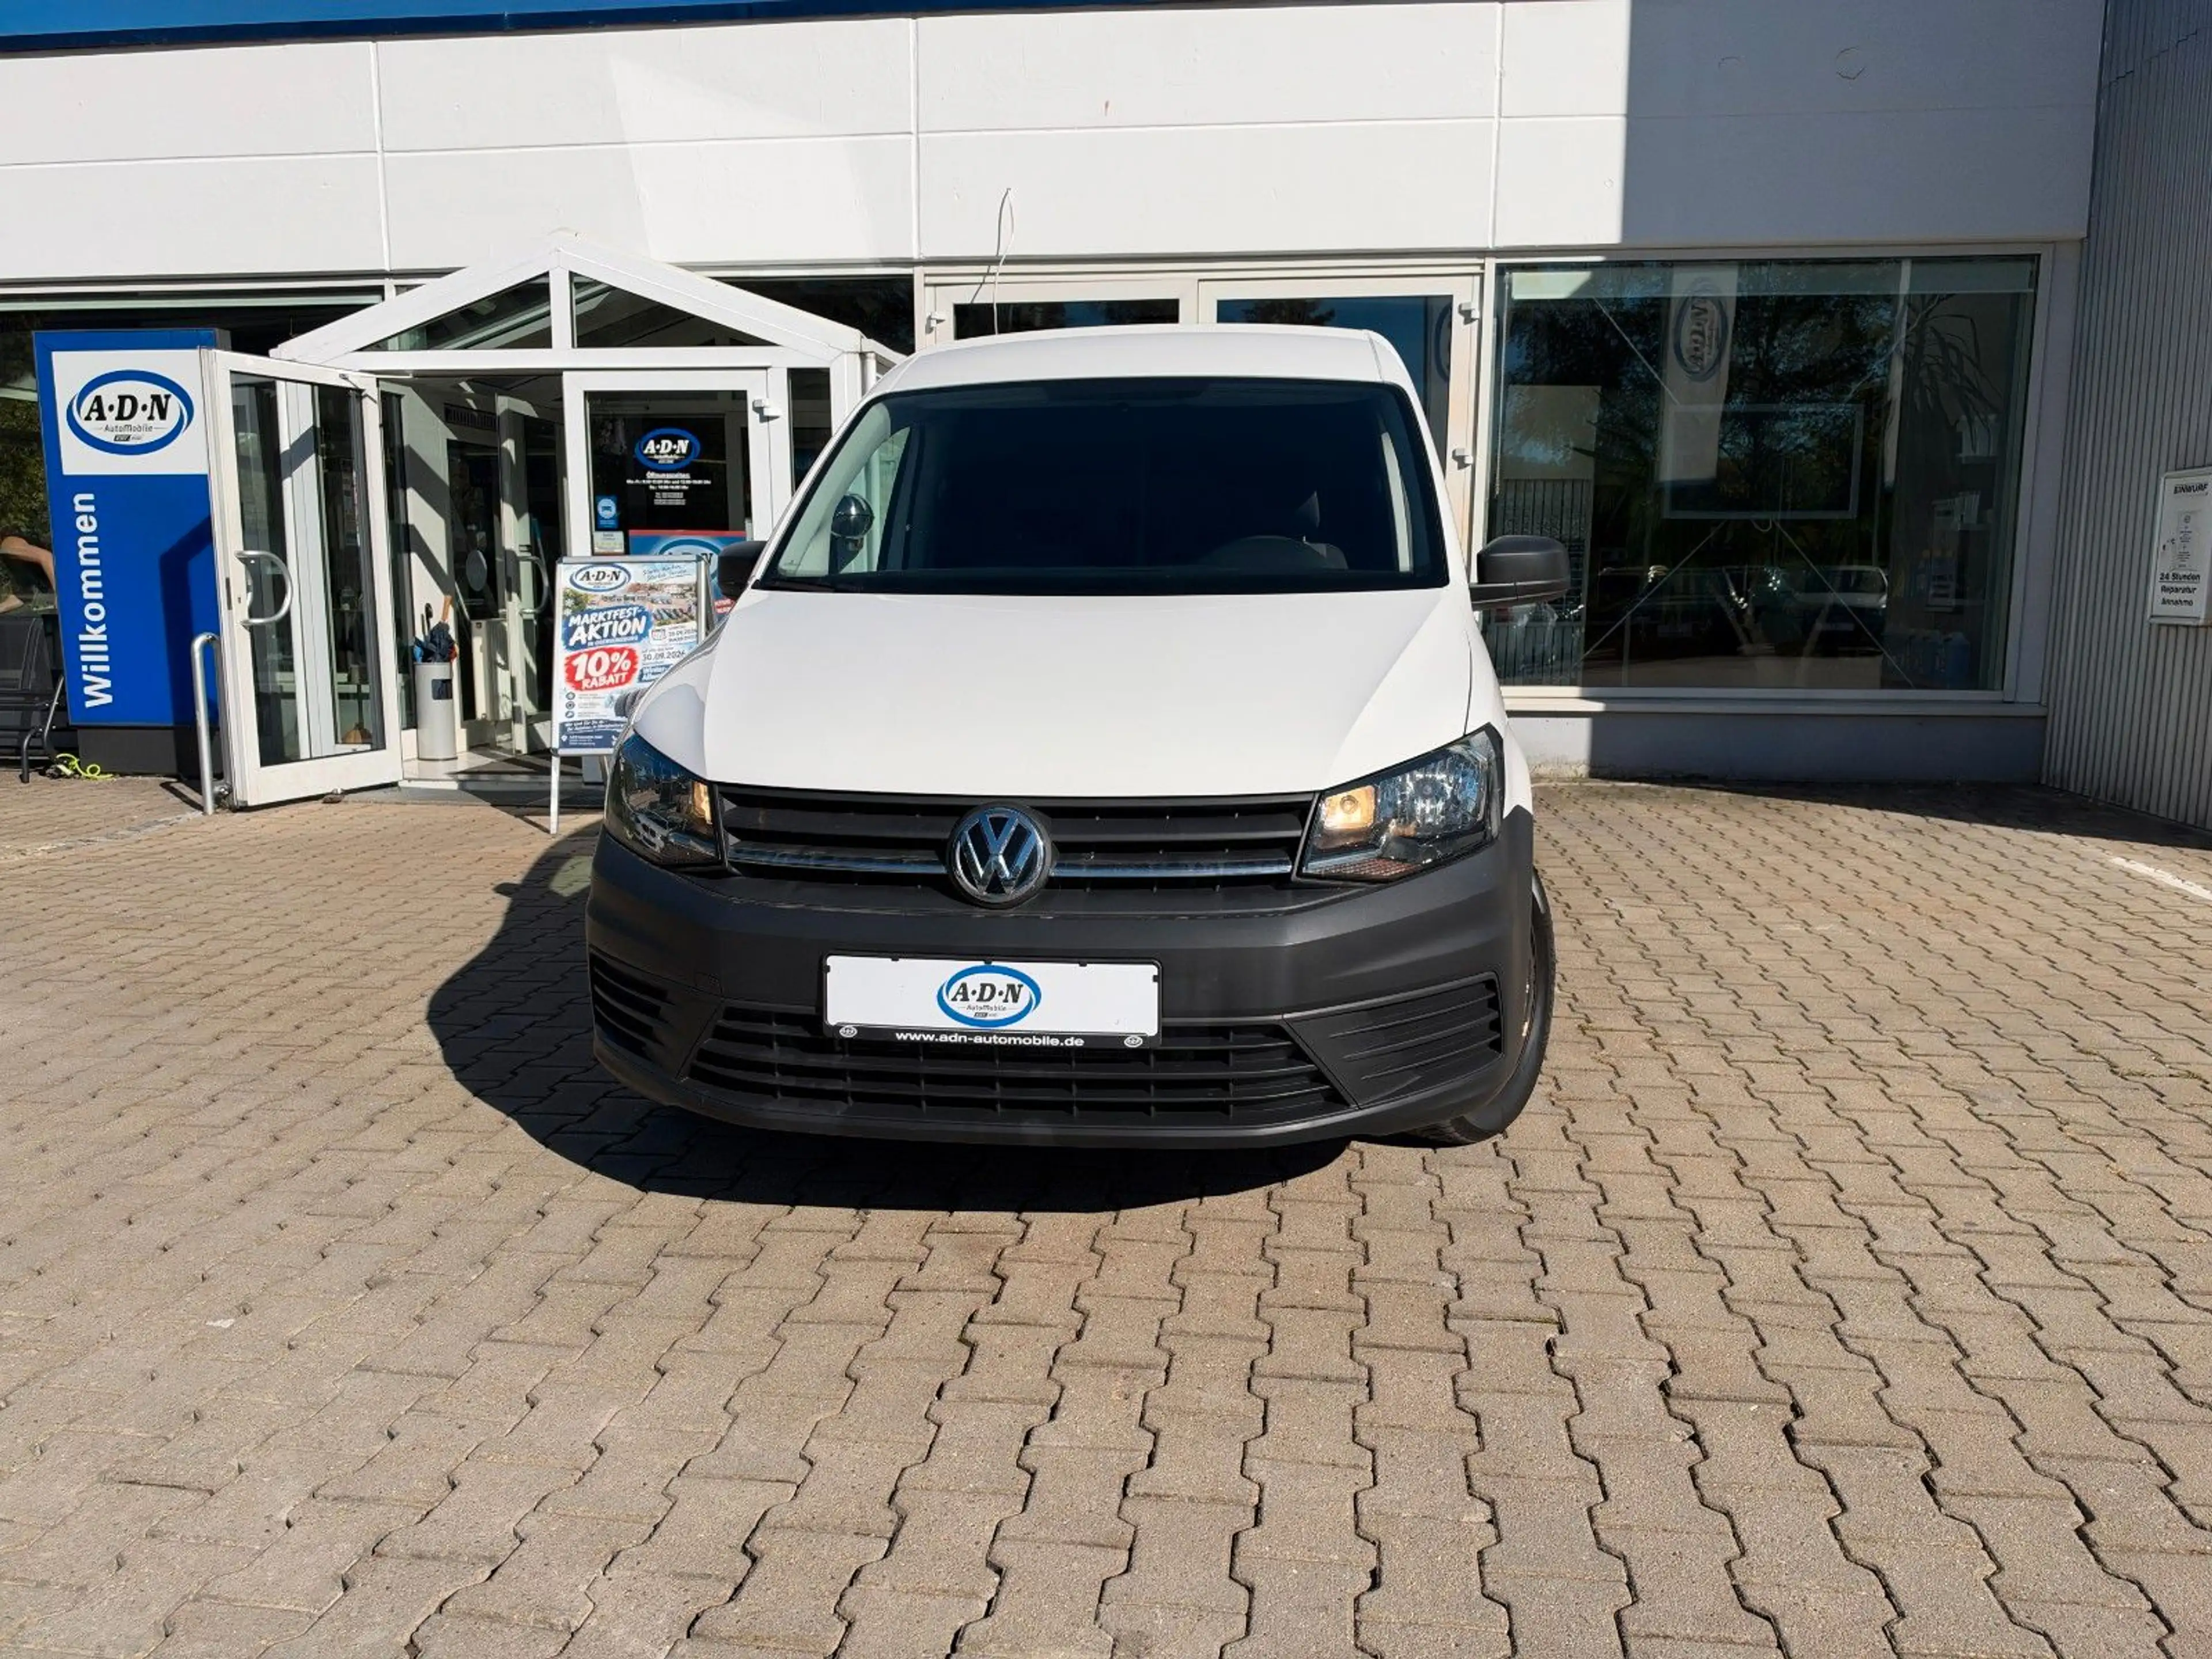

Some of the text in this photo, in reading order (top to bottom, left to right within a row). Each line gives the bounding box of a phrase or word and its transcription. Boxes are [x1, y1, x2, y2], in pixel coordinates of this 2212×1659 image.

[73, 493, 113, 709] Willkommen
[2161, 585, 2197, 594] Reparatur
[569, 616, 646, 646] AKTION
[572, 649, 631, 681] 10%
[581, 672, 628, 690] RABATT
[895, 1032, 1085, 1047] www.adn-automobile.de
